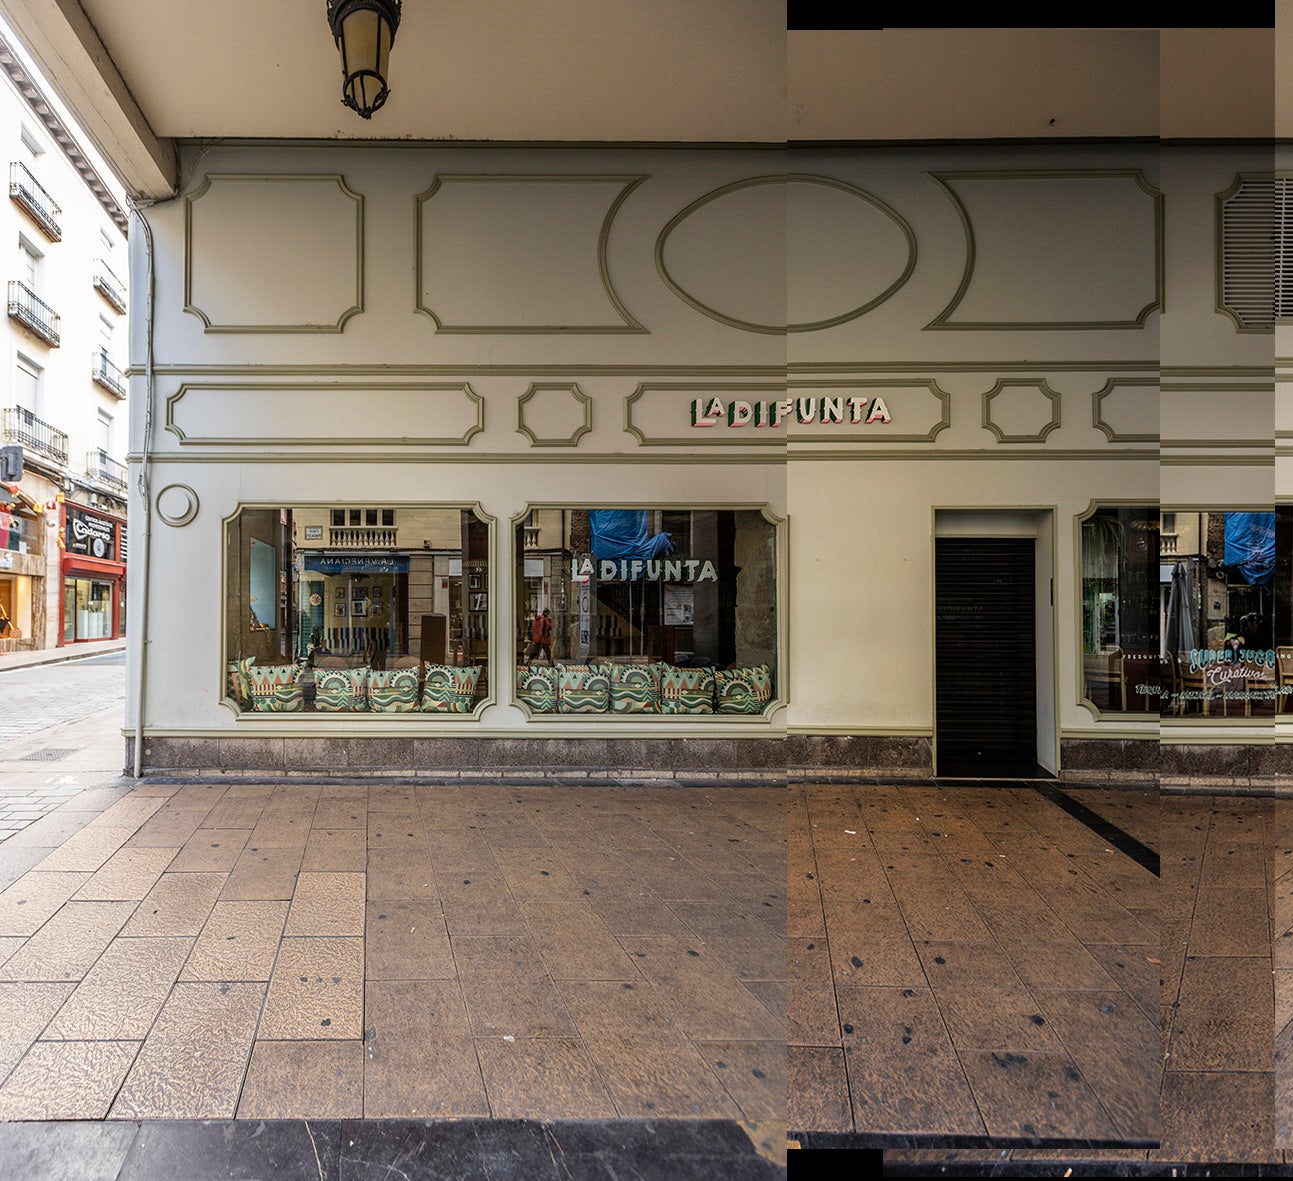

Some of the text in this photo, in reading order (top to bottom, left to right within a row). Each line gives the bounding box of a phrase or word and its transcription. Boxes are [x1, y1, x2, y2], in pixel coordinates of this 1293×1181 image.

[691, 397, 725, 427] LA
[571, 558, 718, 583] LA DIFUNTA
